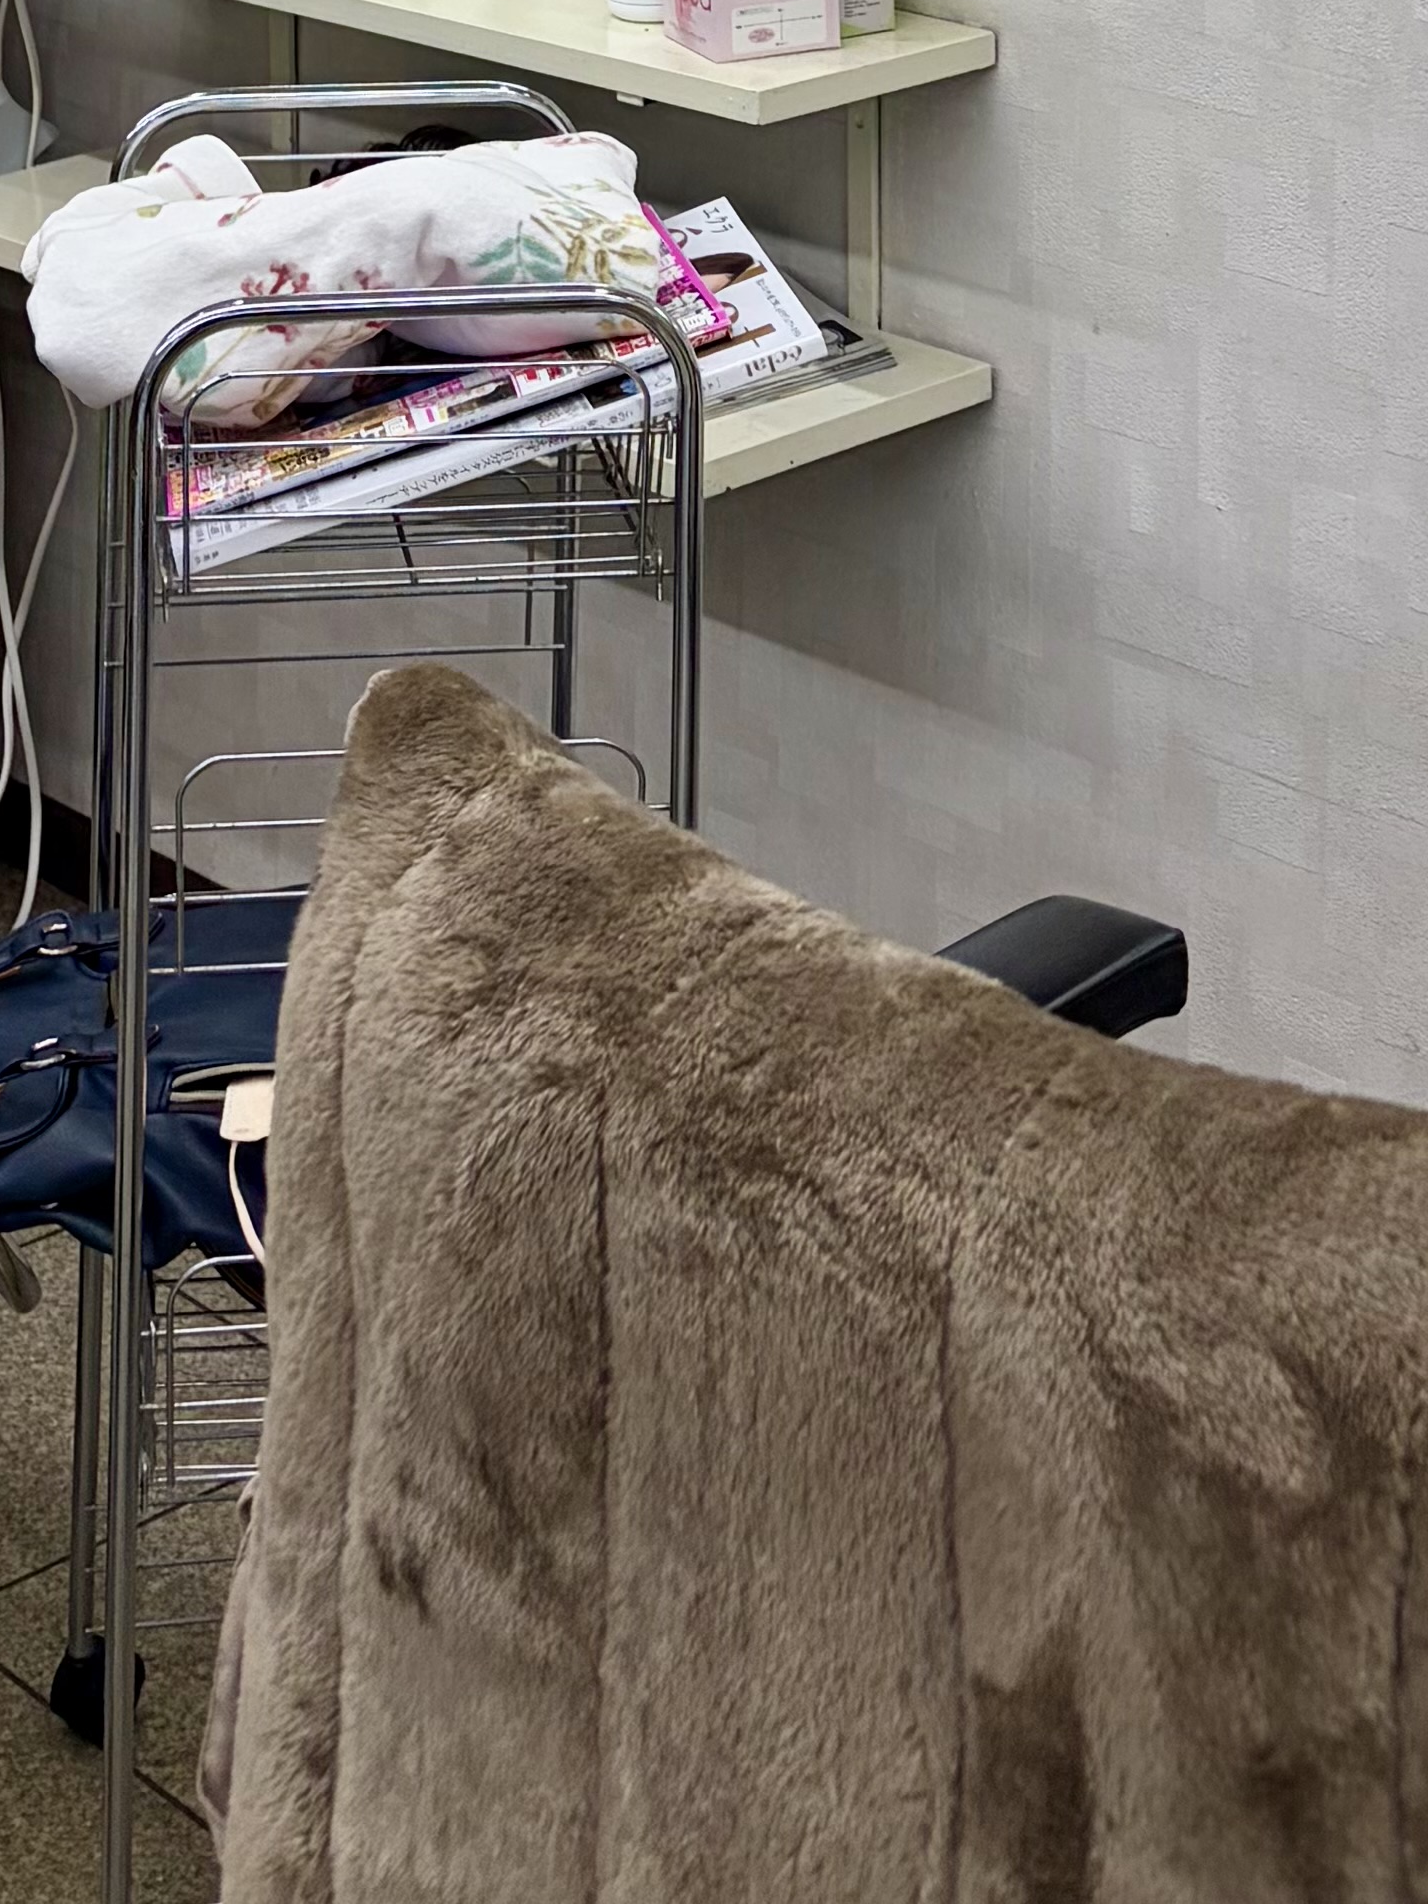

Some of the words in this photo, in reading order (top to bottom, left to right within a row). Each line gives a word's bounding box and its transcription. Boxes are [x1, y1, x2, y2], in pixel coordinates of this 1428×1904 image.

[702, 206, 734, 233] エクラ
[743, 344, 803, 378] éclat
